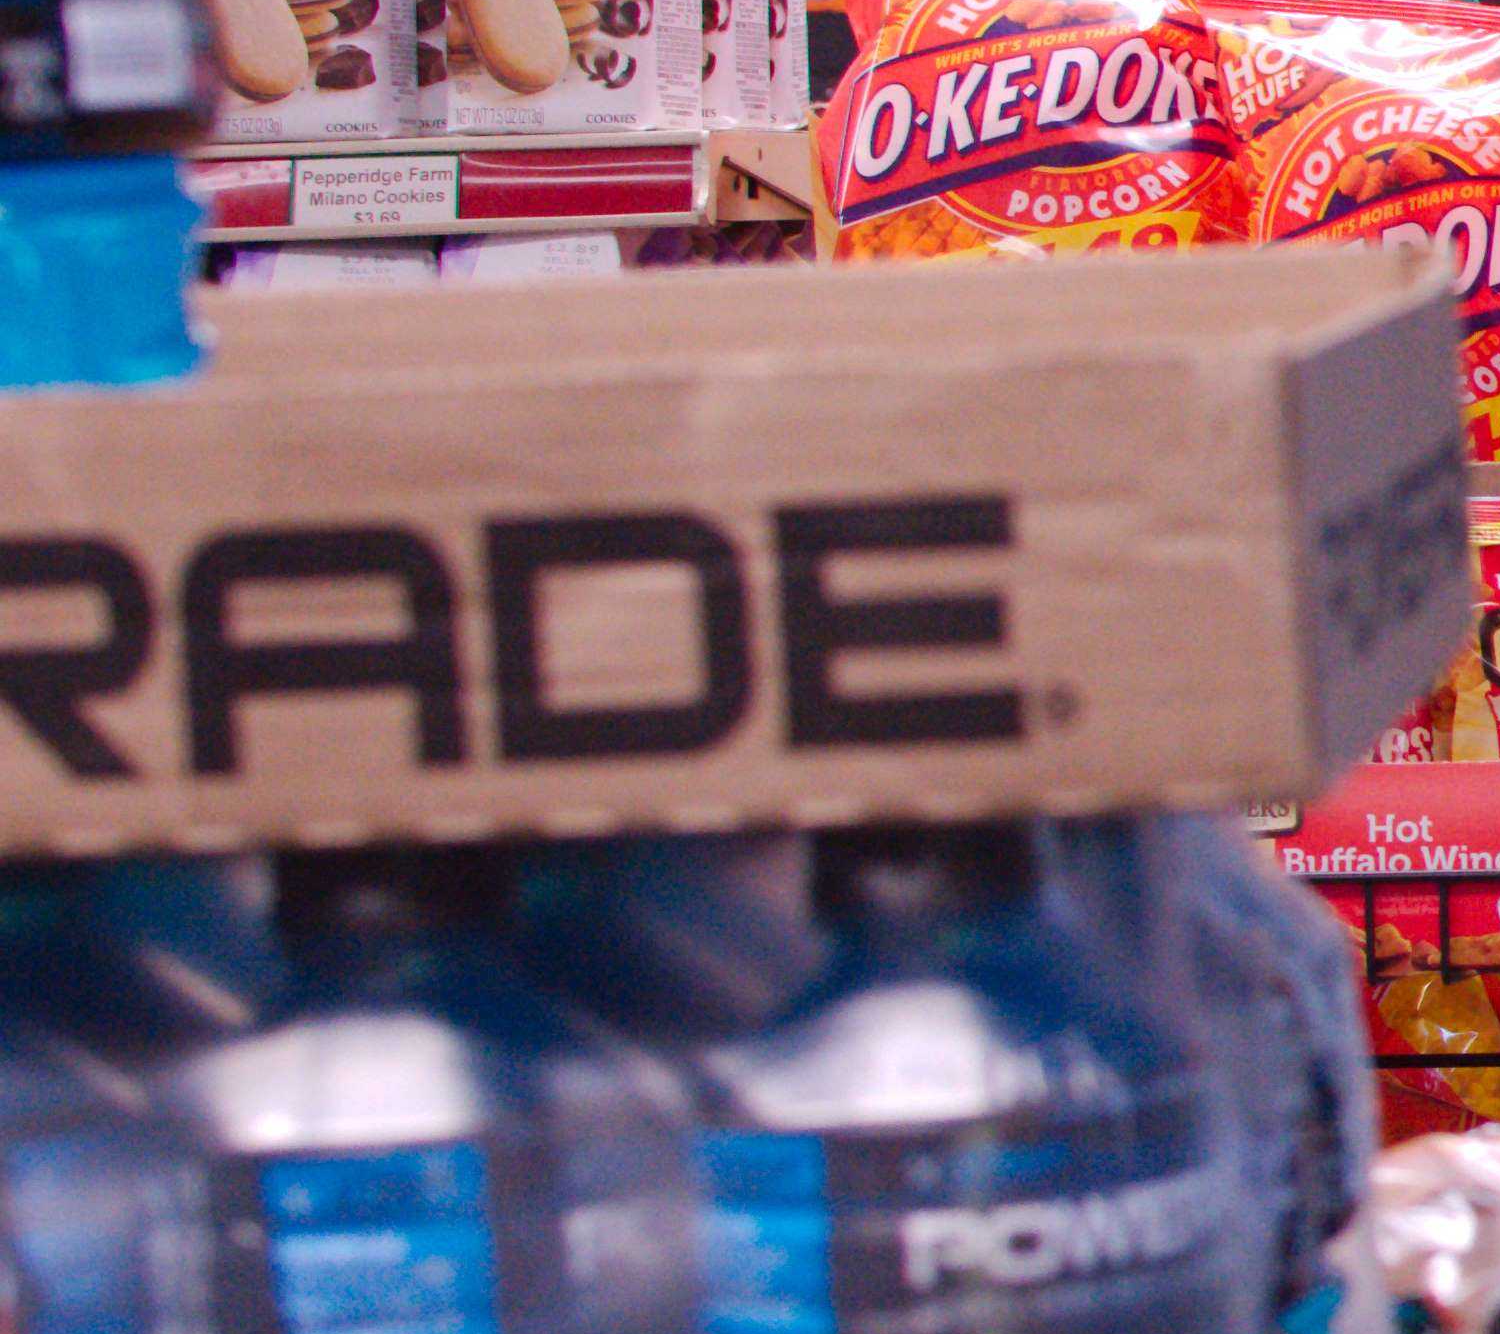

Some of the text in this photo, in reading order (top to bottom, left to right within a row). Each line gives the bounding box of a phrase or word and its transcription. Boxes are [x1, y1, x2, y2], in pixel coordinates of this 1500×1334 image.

[935, 46, 985, 69] WHEN
[990, 38, 1023, 57] IT'S
[1028, 30, 1078, 48] MORE
[1230, 68, 1306, 125] STUFF
[325, 121, 379, 134] COOKIES
[585, 113, 638, 125] COOKIES
[302, 167, 454, 187] Pepperidge Farm
[1284, 123, 1346, 223] HOT
[308, 188, 447, 207] Milano Cookies
[1006, 158, 1192, 224] POPCORN
[352, 210, 402, 224] $369
[1358, 203, 1404, 230] MORE
[1408, 188, 1456, 213] THAN
[1459, 183, 1486, 199] OK
[1366, 812, 1434, 844] Hot
[1282, 846, 1412, 875] Buffalo
